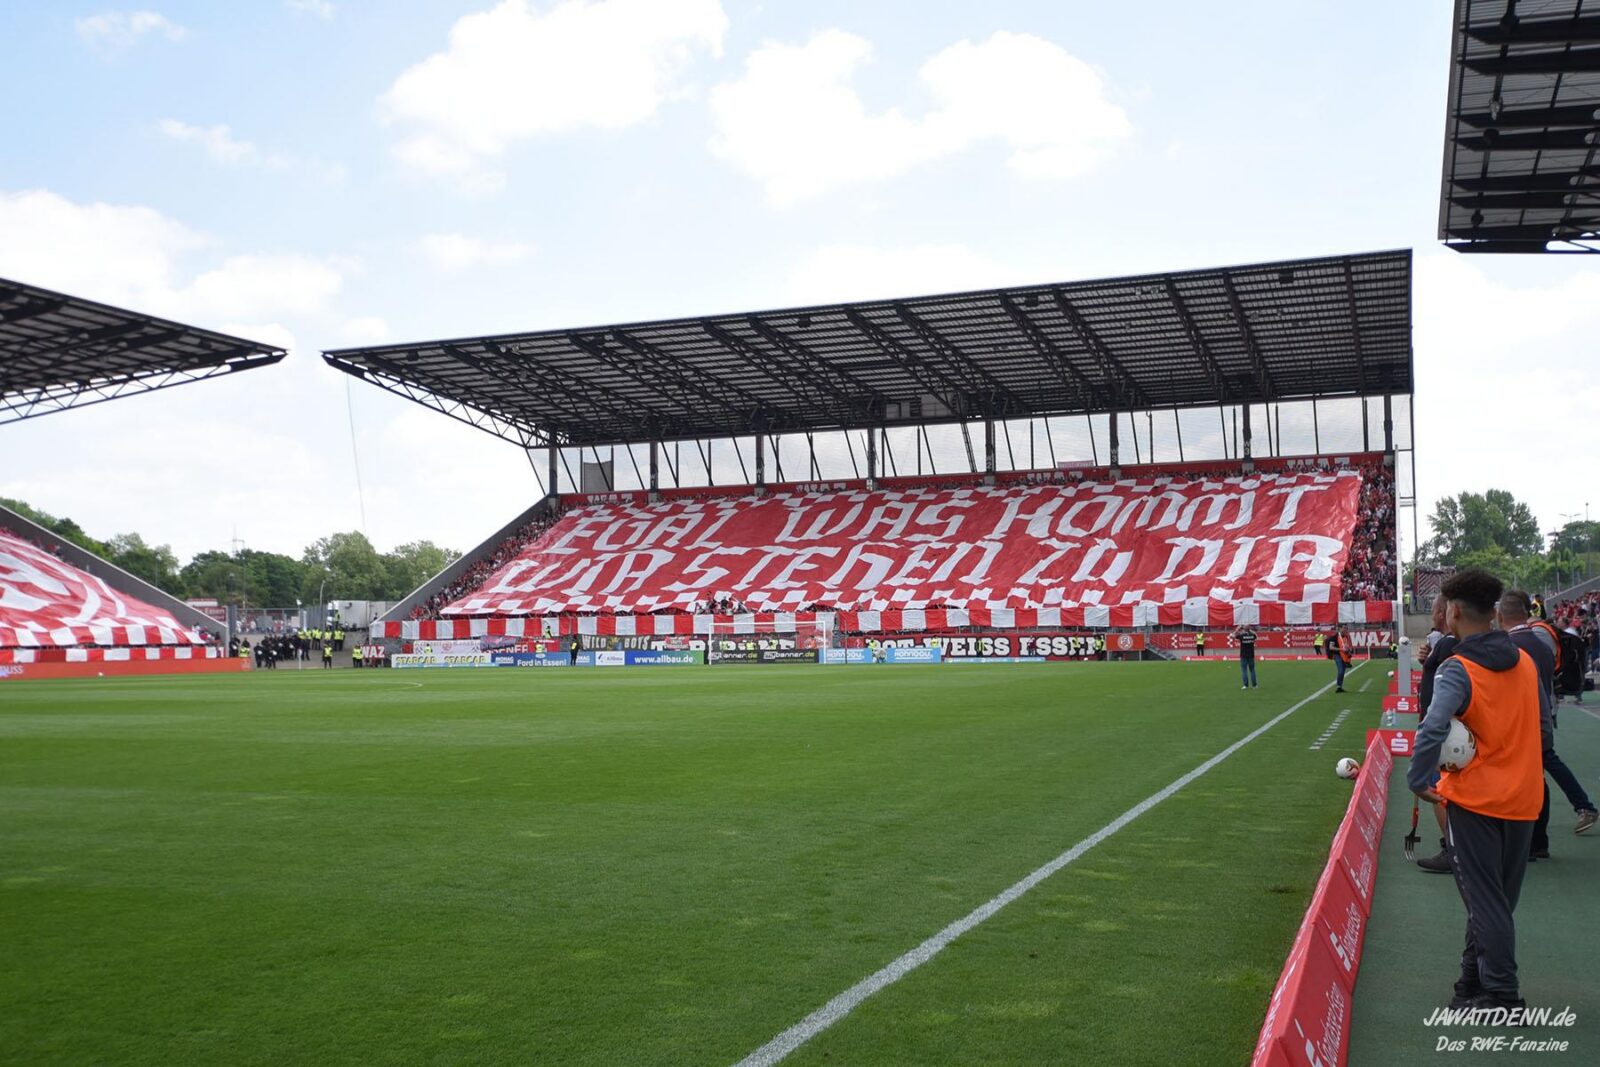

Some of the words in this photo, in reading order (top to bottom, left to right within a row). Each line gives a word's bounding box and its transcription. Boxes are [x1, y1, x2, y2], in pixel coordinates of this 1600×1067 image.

[542, 509, 738, 554] EGAL
[774, 499, 978, 543] WAS
[489, 549, 676, 596] WIR
[1147, 535, 1344, 587] DIR
[581, 635, 606, 650] WILD
[624, 634, 650, 650] BOYS
[1350, 631, 1390, 647] WAZ
[361, 645, 385, 658] WAZ
[634, 655, 694, 664] www.allbau.de
[517, 659, 534, 667] Ford
[535, 659, 541, 667] in
[542, 659, 567, 667] Essen!
